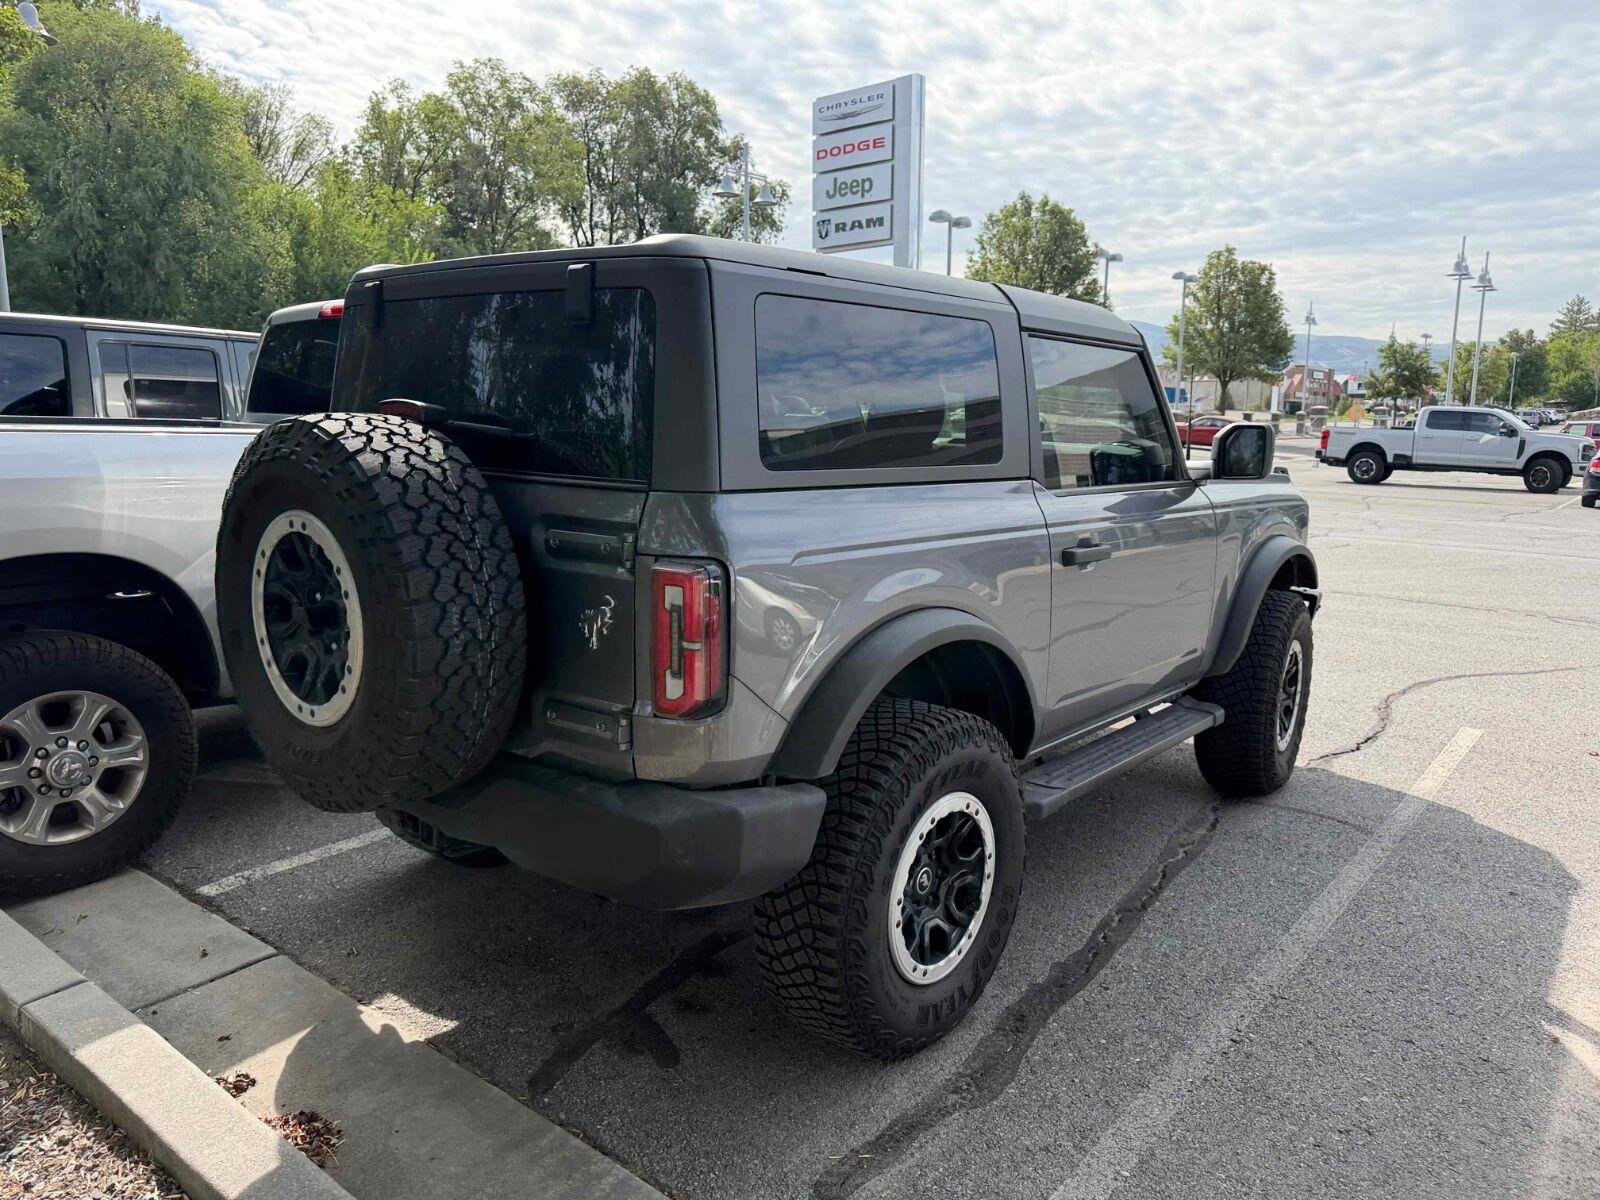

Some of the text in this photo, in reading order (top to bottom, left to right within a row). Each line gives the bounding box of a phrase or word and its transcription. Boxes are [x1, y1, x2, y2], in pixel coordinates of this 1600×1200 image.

[818, 93, 884, 113] CHRYSLER
[816, 136, 885, 160] DODGE
[826, 176, 873, 199] Jeep
[834, 216, 884, 234] RAM
